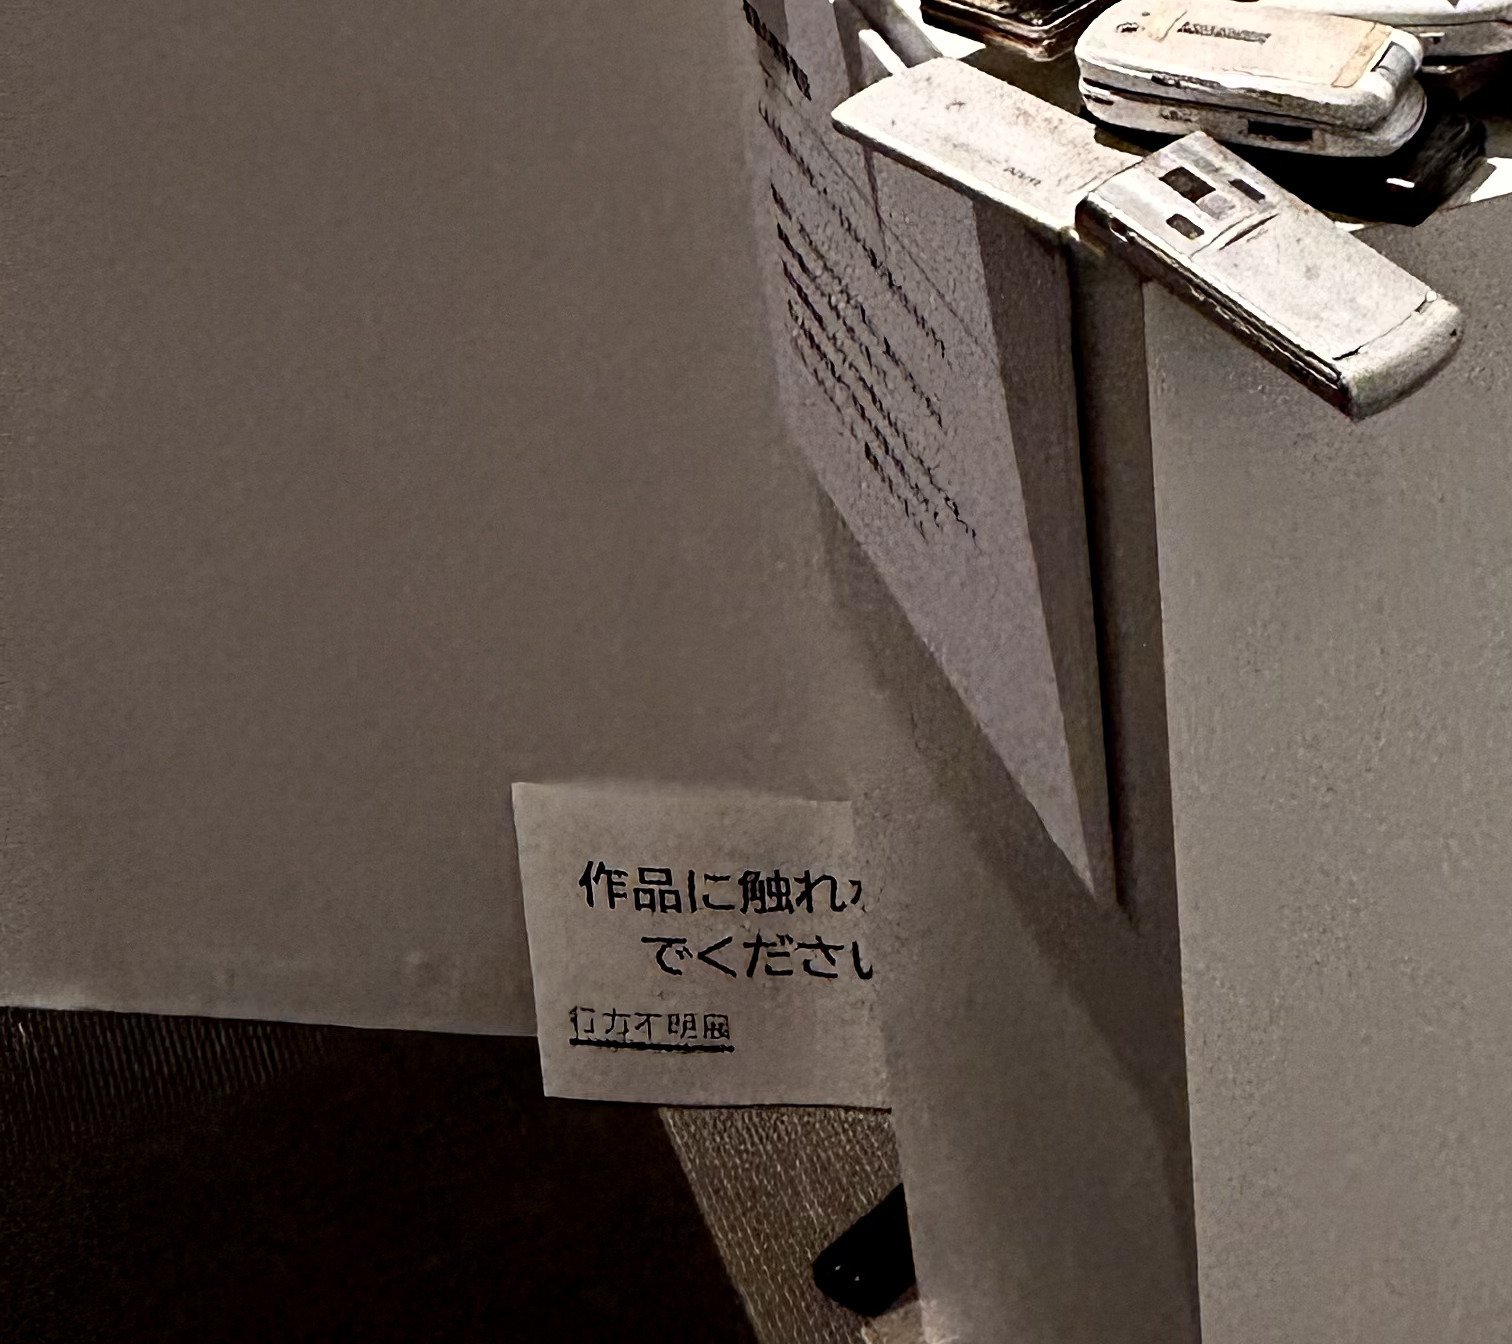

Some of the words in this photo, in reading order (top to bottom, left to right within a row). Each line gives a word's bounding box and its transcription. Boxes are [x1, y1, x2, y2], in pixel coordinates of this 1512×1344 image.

[569, 1005, 731, 1041] 行方不明展
